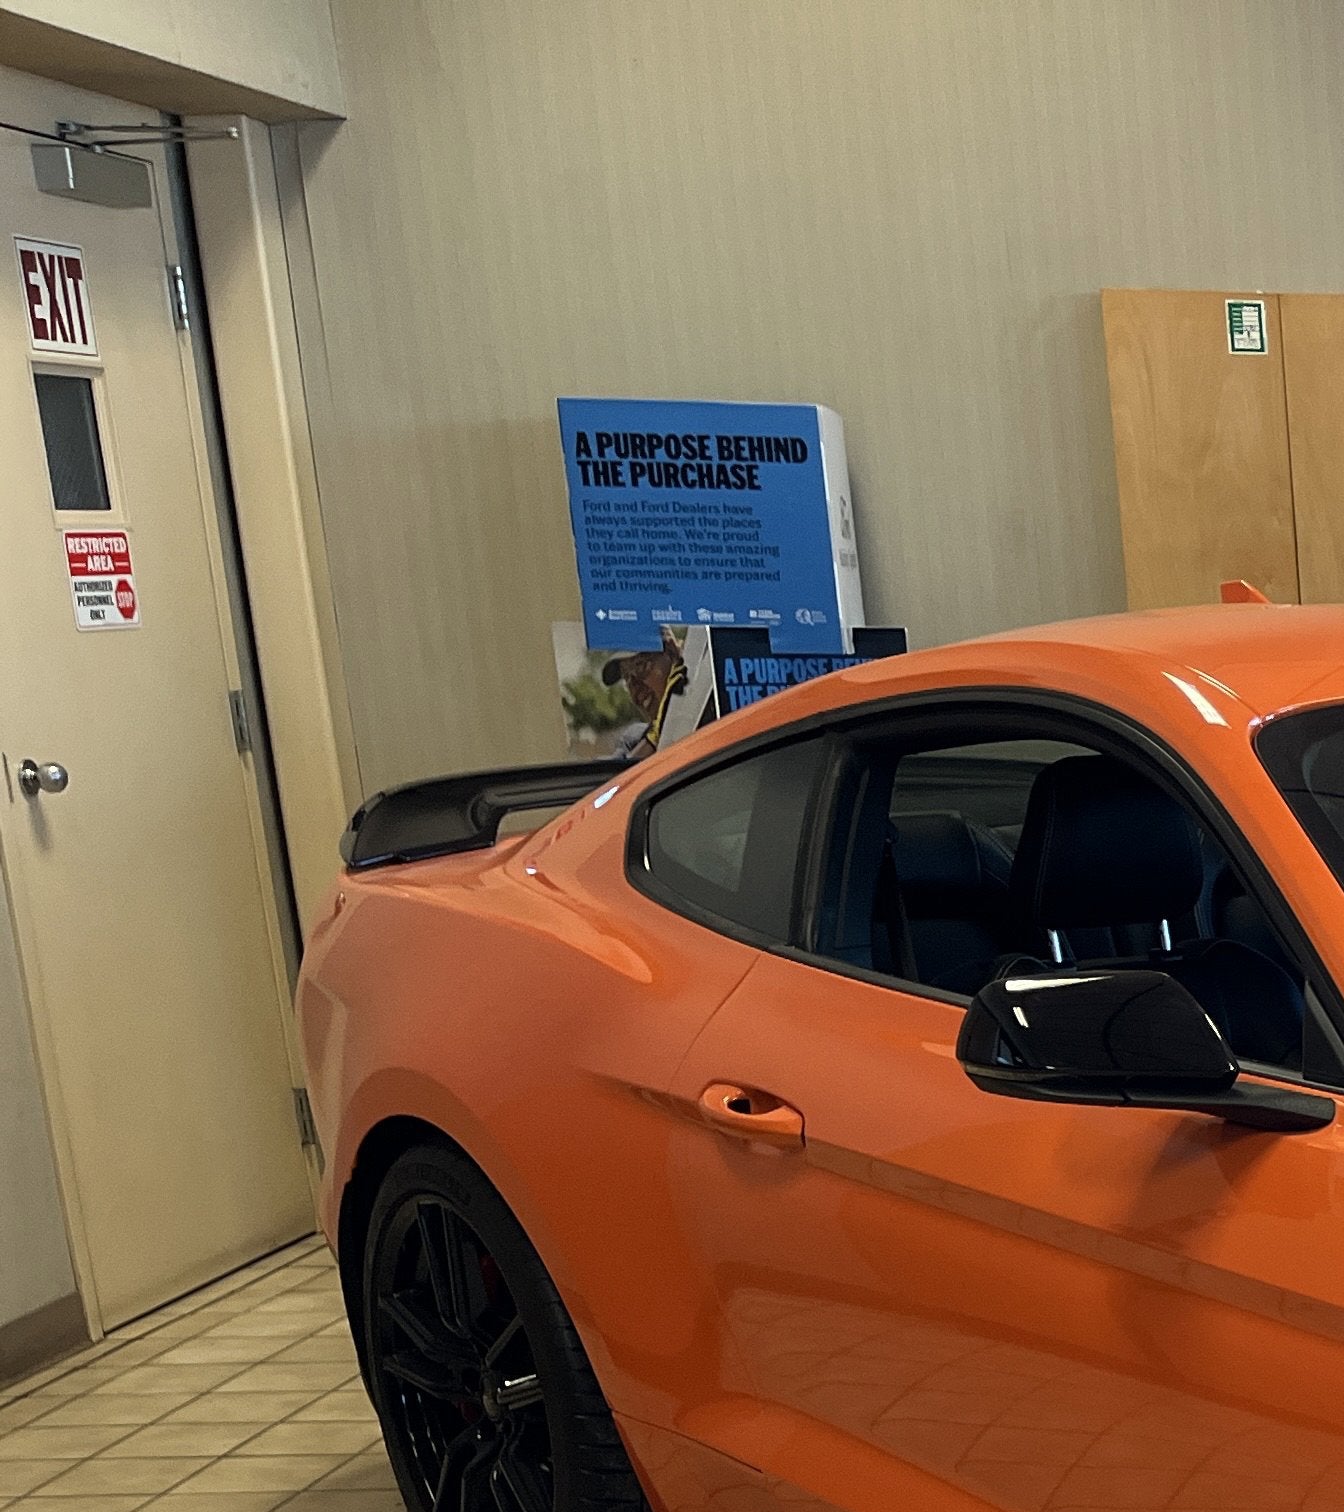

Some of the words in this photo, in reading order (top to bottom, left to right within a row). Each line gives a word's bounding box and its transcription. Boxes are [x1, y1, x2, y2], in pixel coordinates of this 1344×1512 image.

[20, 249, 89, 345] EXIT
[576, 431, 592, 459] A
[596, 432, 713, 461] PURPOSE
[715, 435, 808, 464] BEHIND
[577, 460, 626, 488] THE
[629, 461, 761, 491] PURCHASE
[582, 500, 611, 513] Ford
[614, 501, 638, 513] and
[641, 501, 669, 513] Ford
[672, 502, 721, 514] Dealers
[723, 503, 752, 515] have
[585, 513, 627, 526] always
[630, 515, 695, 528] supported
[699, 516, 719, 527] the
[722, 517, 762, 530] places
[585, 527, 614, 540] they
[617, 528, 639, 539] call
[642, 528, 680, 540] home.
[684, 529, 719, 540] We're
[723, 530, 760, 542] proud
[66, 536, 127, 554] RESTRICTED
[588, 542, 600, 551] to
[603, 541, 636, 551] team
[639, 543, 656, 554] up
[658, 542, 685, 553] with
[725, 544, 780, 558] amazing
[87, 555, 115, 571] AREA
[678, 555, 691, 566] to
[694, 556, 738, 567] ensure
[740, 556, 765, 568] that
[591, 568, 611, 578] our
[615, 567, 698, 580] communities
[701, 570, 722, 580] are
[725, 570, 781, 582] prepared
[593, 580, 617, 592] and
[724, 658, 739, 684] A
[740, 658, 829, 684] PURPOSE
[725, 685, 763, 711] THE
